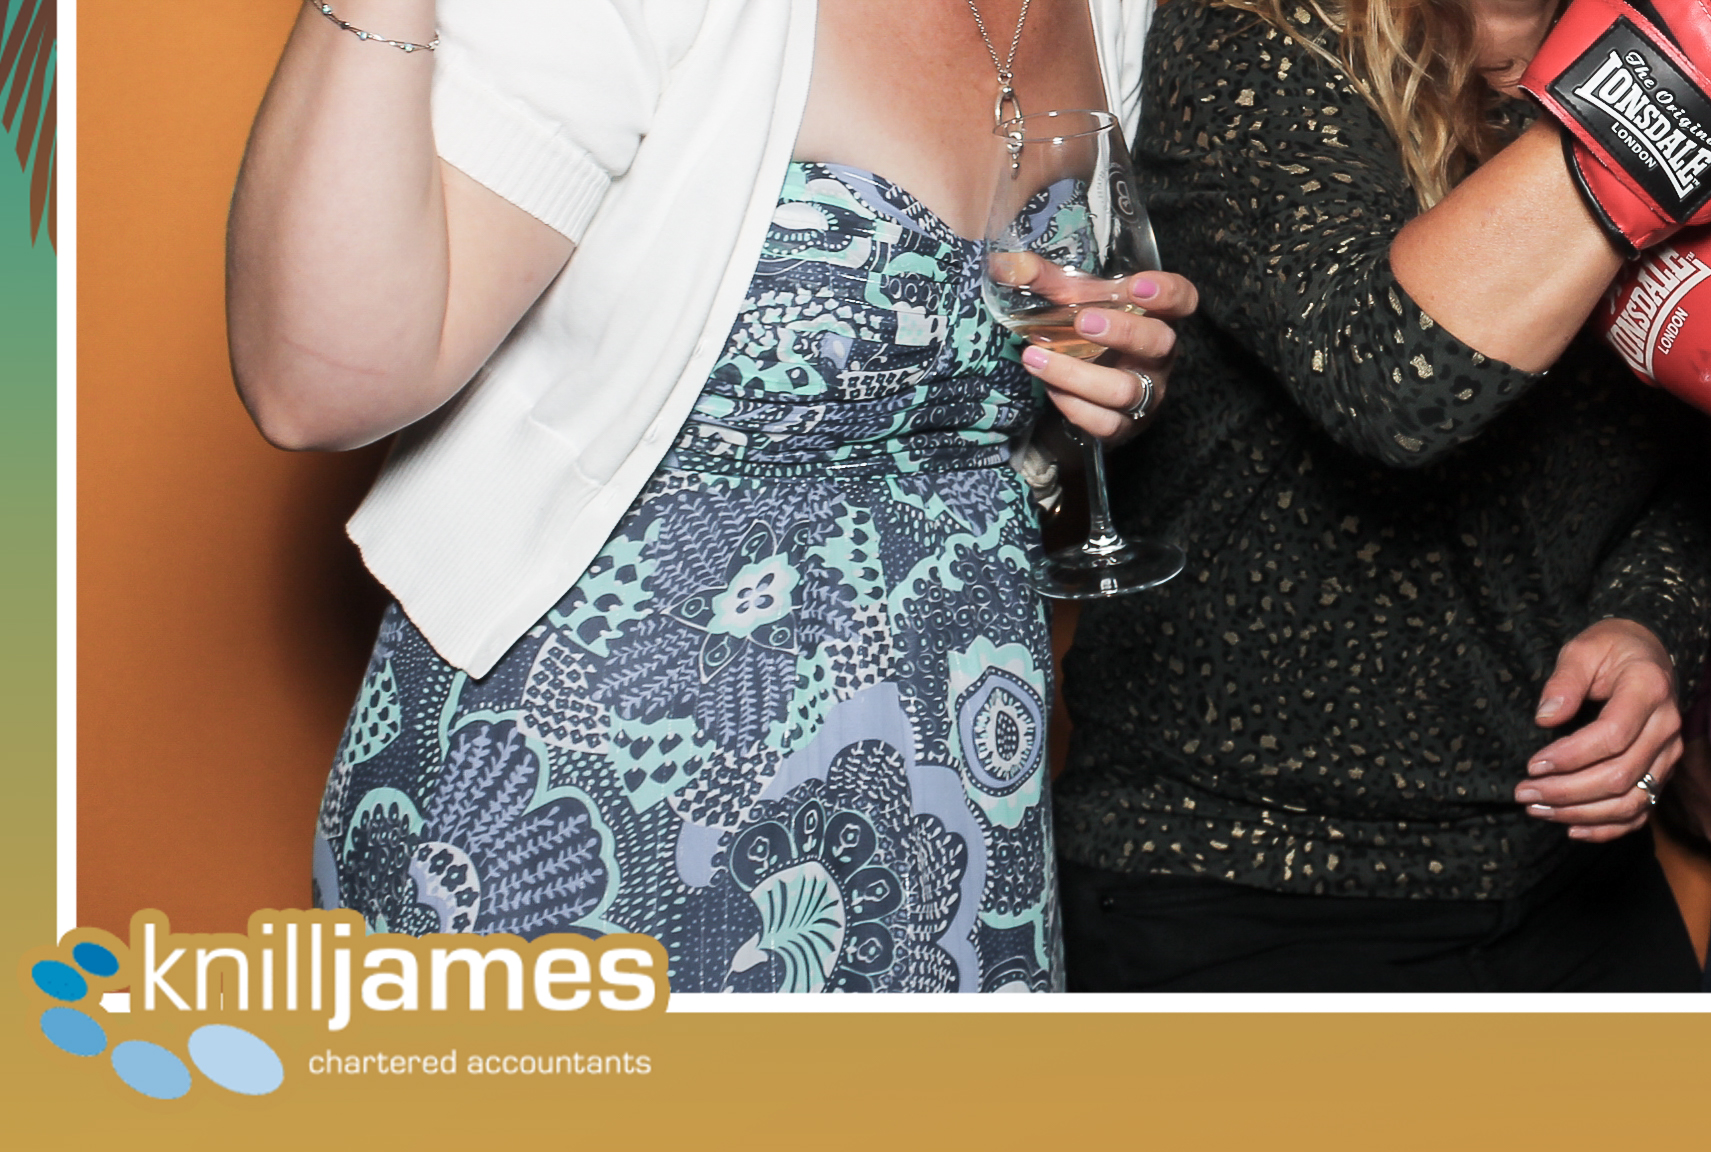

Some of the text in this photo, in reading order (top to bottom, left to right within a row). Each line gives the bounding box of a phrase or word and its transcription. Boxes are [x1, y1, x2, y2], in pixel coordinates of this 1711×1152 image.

[1624, 51, 1656, 89] The
[1611, 121, 1657, 169] LONDON
[1657, 306, 1689, 356] LONDON
